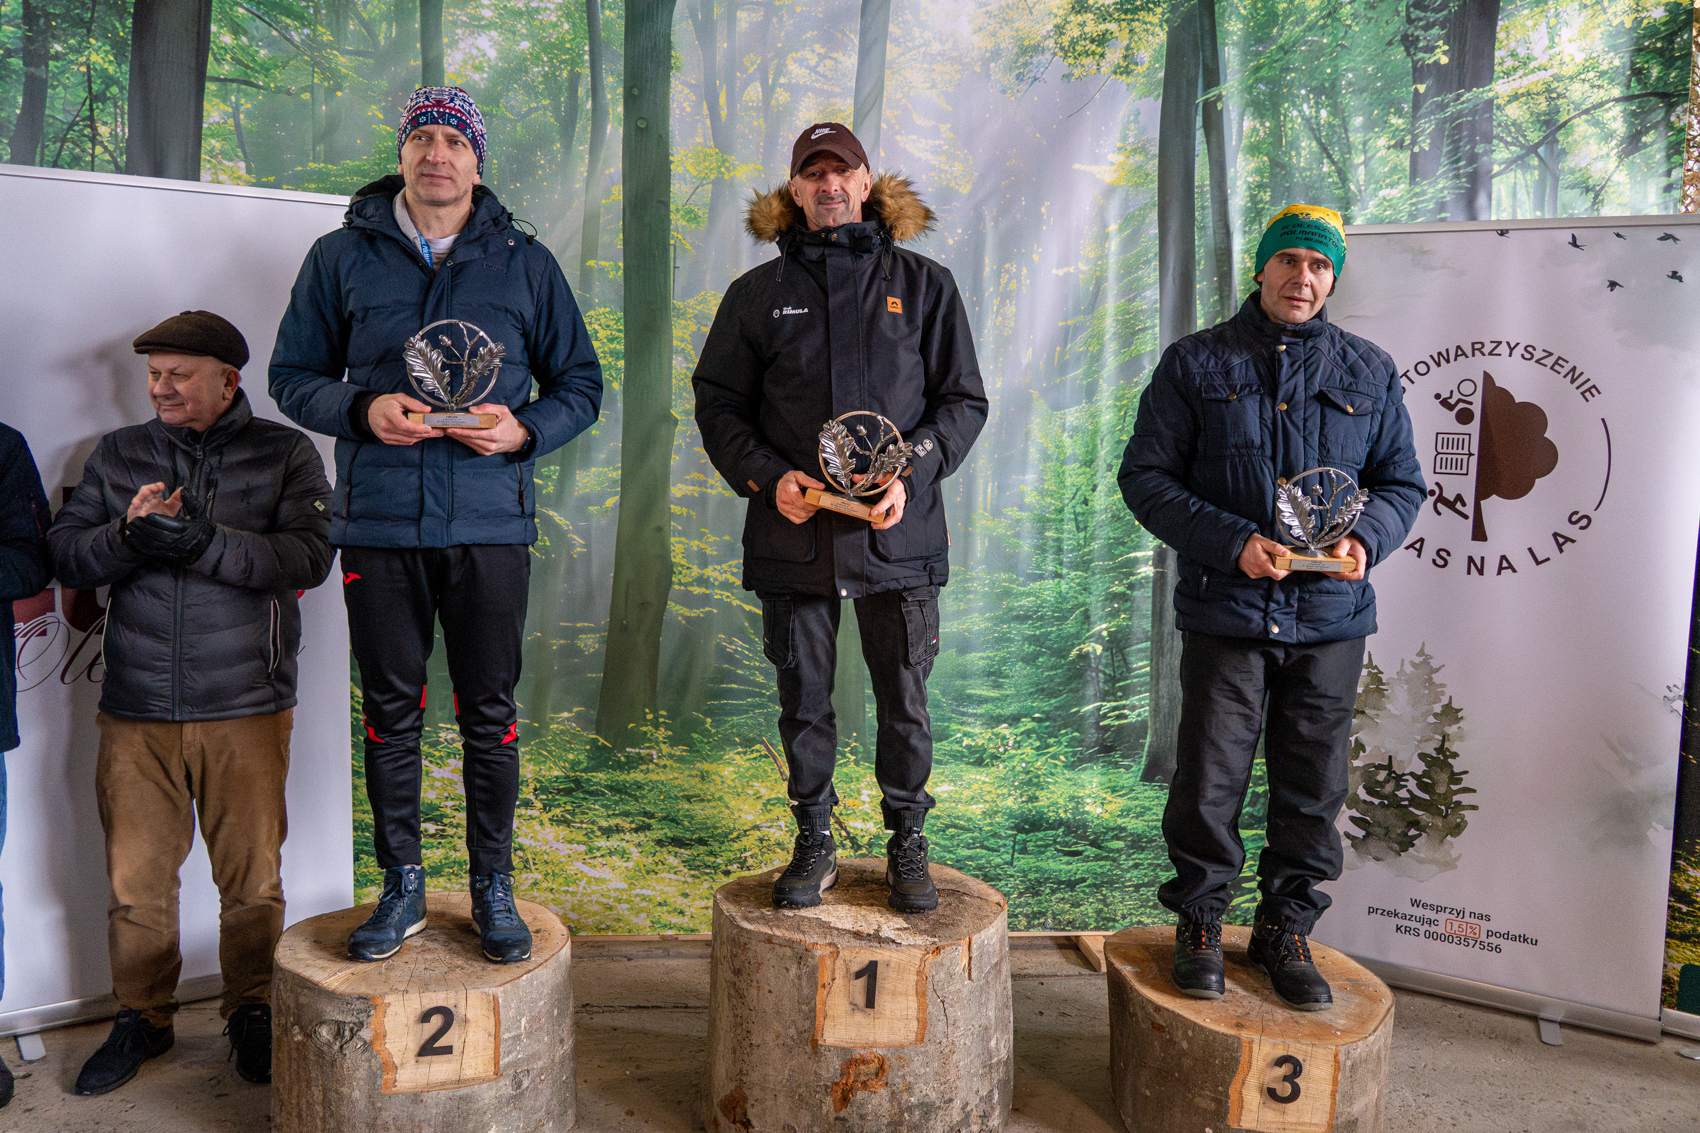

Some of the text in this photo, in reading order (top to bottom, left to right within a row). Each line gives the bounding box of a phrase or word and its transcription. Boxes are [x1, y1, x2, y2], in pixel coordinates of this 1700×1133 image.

[782, 307, 809, 315] RIMULA
[1400, 340, 1602, 403] TOWARZYSZENIE
[1403, 536, 1452, 569] AS
[1367, 905, 1440, 927] przekazując
[1486, 927, 1539, 946] podatku
[1410, 898, 1491, 922] Wesprzyj nas
[1395, 924, 1502, 954] KRS 0000357556
[854, 959, 878, 1009] 1
[415, 1005, 455, 1058] 2
[1266, 1054, 1303, 1104] 3
